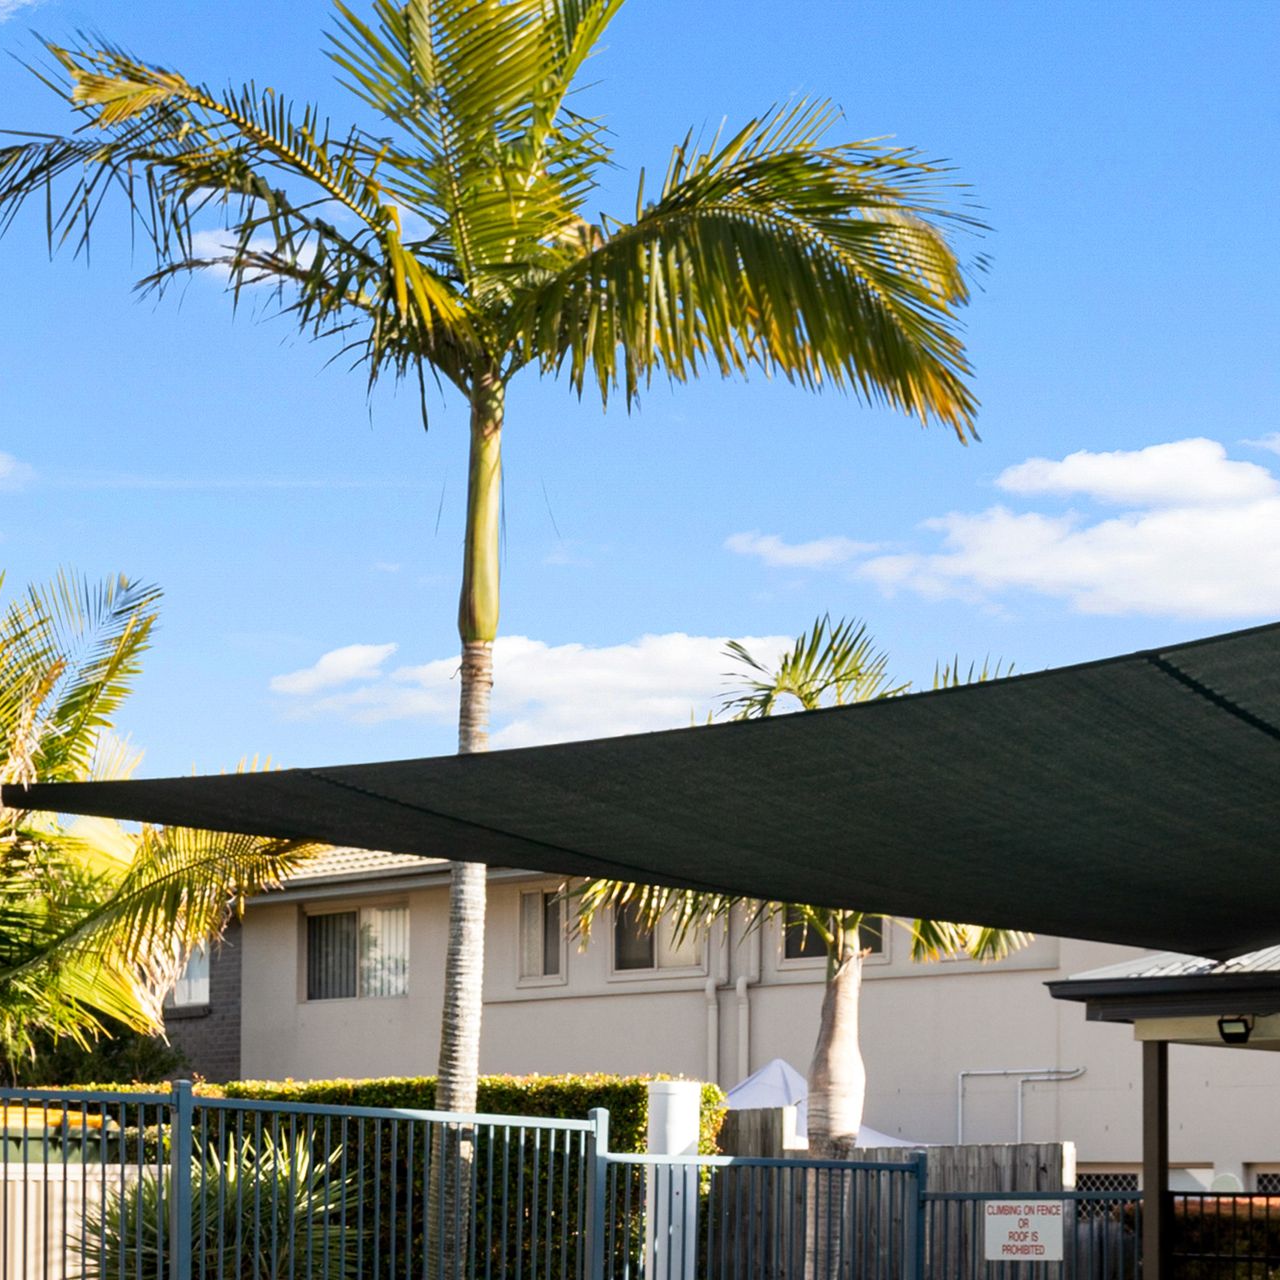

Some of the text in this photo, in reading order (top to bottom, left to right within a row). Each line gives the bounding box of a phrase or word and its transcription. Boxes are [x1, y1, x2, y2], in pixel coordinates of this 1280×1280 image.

[987, 1204, 1061, 1216] CLIMBING ON FENCE
[1017, 1218, 1029, 1229] OR
[1008, 1231, 1039, 1242] ROOF IS
[1001, 1244, 1045, 1255] PROHIBITED
